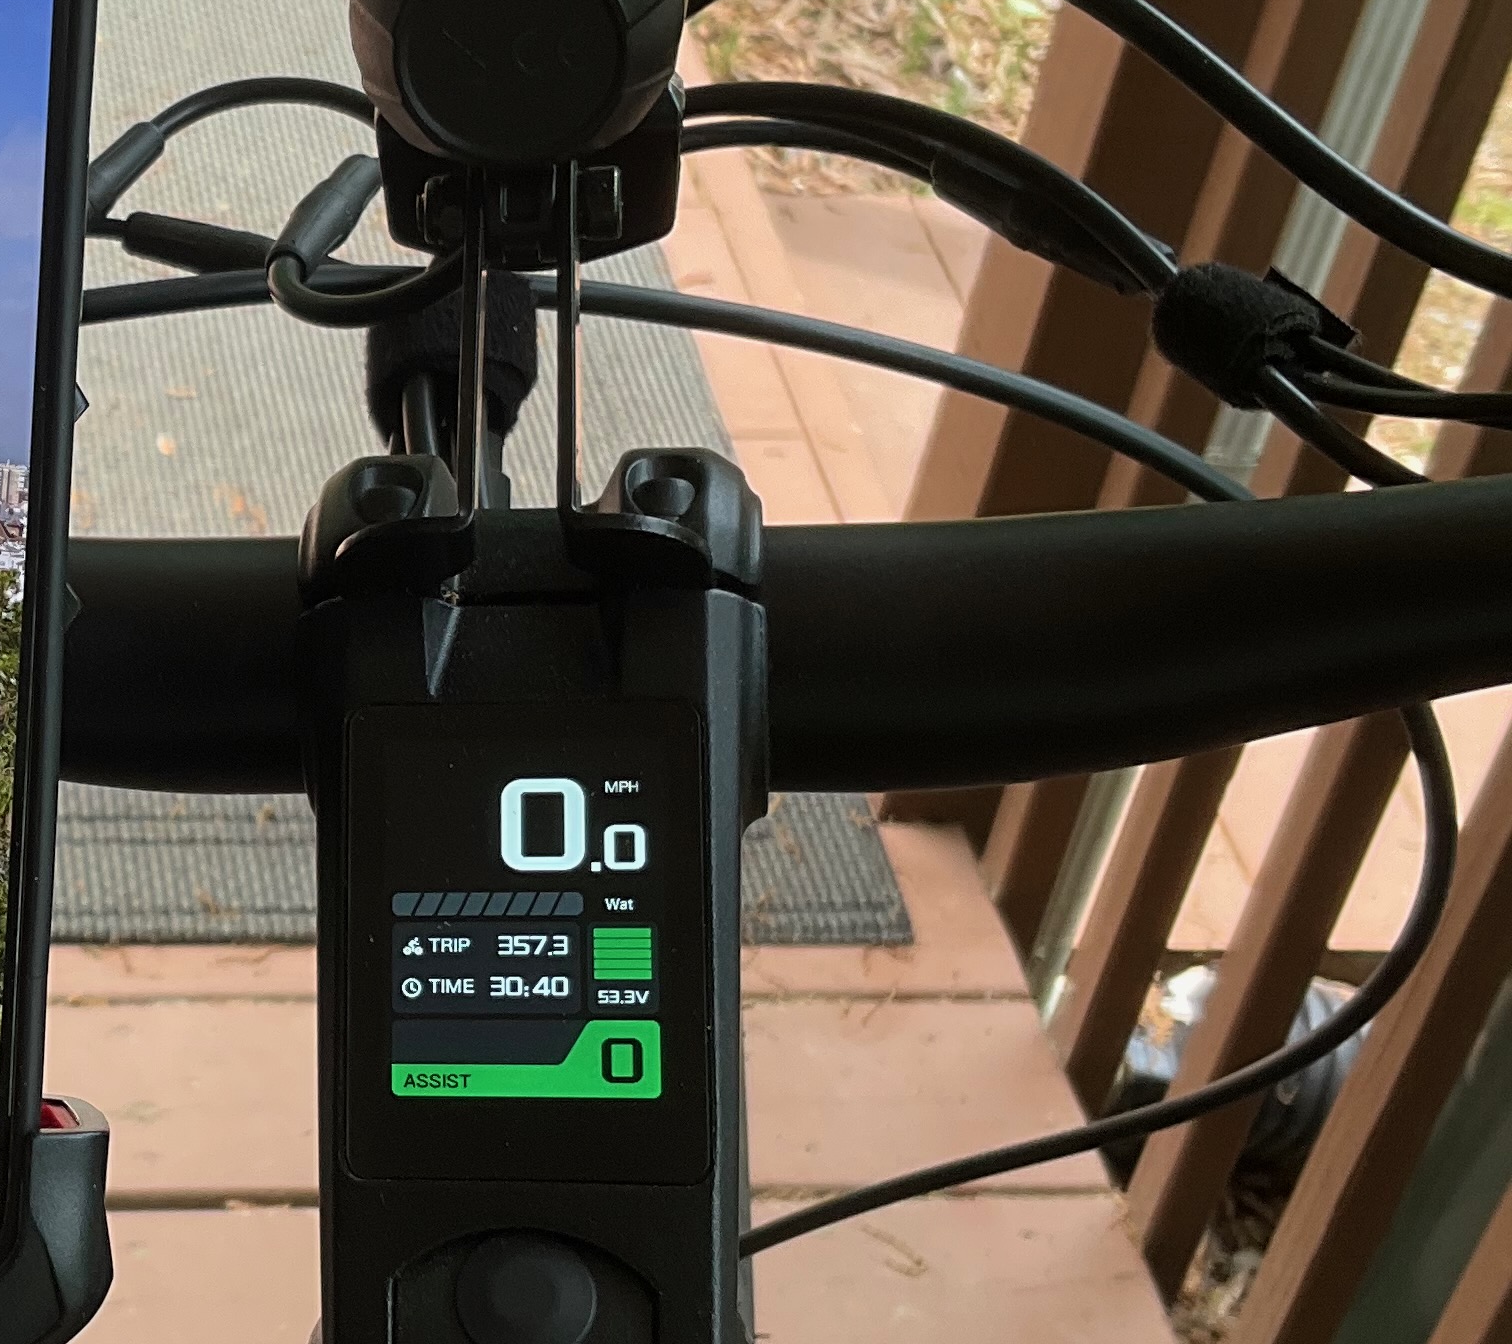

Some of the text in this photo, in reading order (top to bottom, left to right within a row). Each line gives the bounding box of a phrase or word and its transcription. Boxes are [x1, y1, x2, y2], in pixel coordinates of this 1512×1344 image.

[604, 780, 640, 794] MPH
[604, 897, 635, 911] Wat
[428, 935, 570, 956] TRIP 357.3
[428, 976, 570, 997] TIME 30:40
[597, 989, 651, 1005] 53.3V
[403, 1073, 472, 1090] ASSIST
